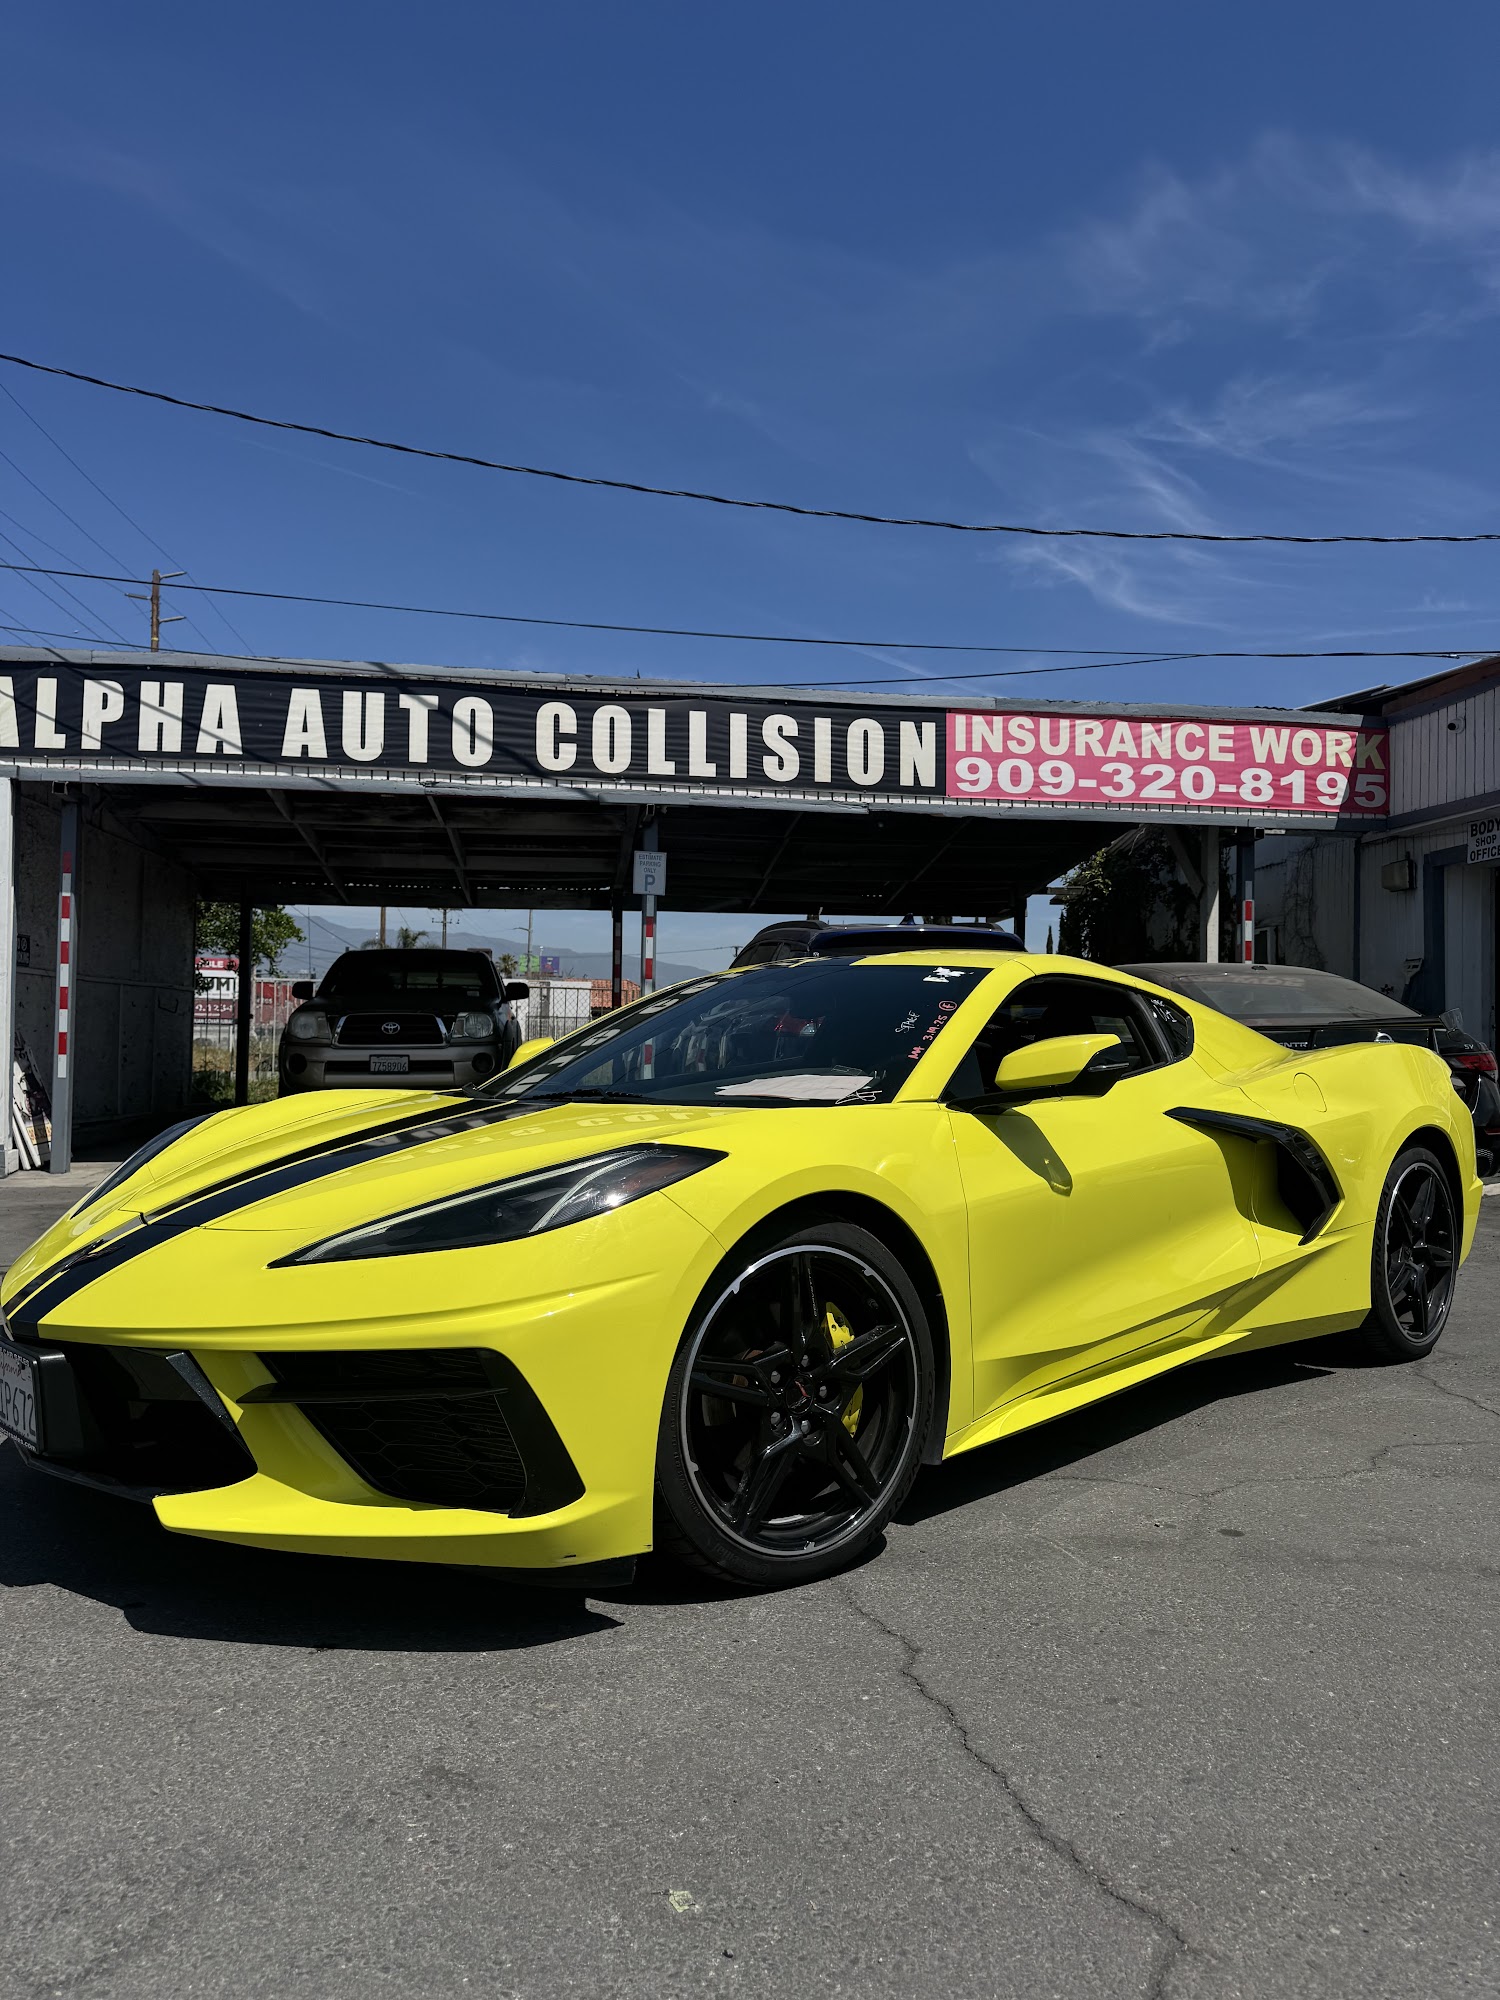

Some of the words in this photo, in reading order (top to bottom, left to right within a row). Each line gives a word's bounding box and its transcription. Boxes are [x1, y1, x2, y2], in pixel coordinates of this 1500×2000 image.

[281, 688, 493, 767] AUTO
[535, 701, 937, 788] COLLISION
[955, 714, 1235, 763] INSURANCE
[1249, 727, 1386, 770] WORK
[955, 756, 1387, 809] 909-320-8195
[1471, 818, 1500, 837] BODY
[1475, 834, 1497, 847] SHOP
[640, 860, 661, 868] PARKING
[644, 874, 656, 892] P
